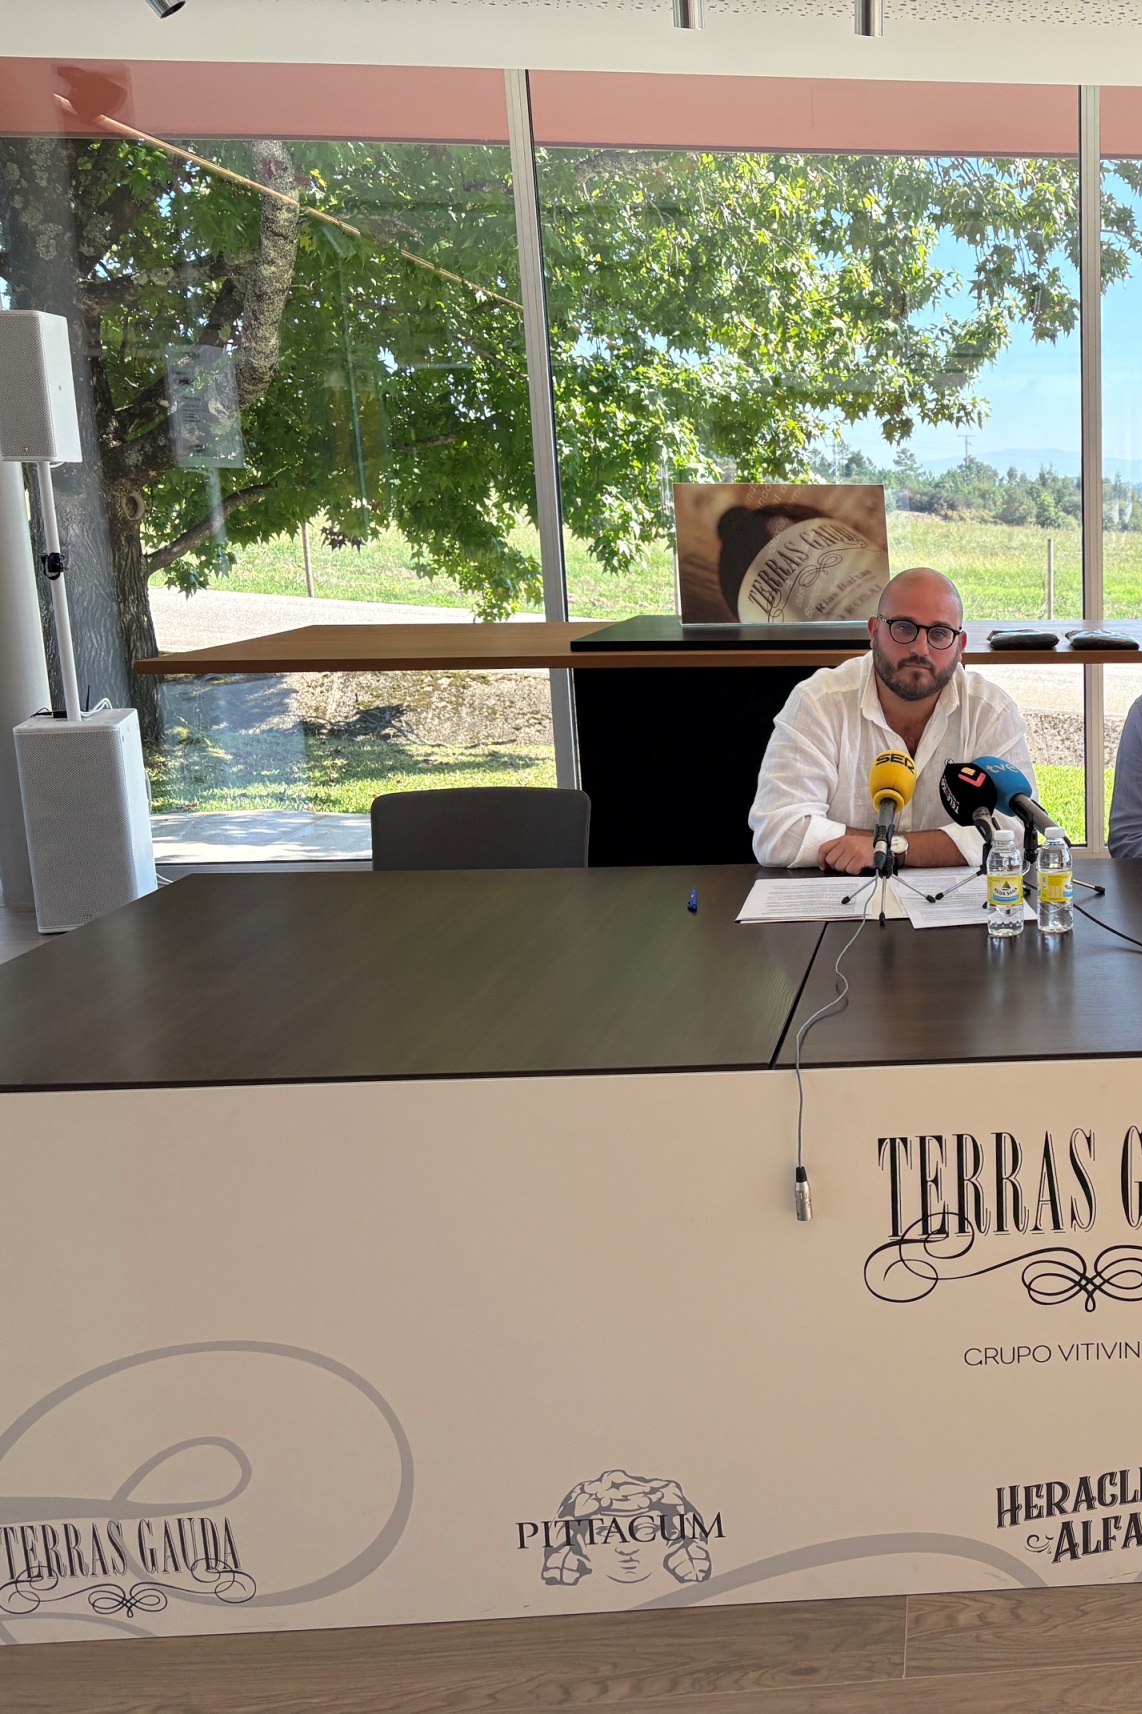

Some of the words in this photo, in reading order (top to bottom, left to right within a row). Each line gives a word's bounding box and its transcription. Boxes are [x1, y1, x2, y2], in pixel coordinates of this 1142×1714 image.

[748, 541, 809, 614] TERRAS
[875, 753, 916, 775] SER
[985, 763, 1020, 774] tve
[878, 1128, 1098, 1241] TERRAS
[964, 1344, 1052, 1366] GRUPO
[0, 1520, 127, 1580] TERRAS
[137, 1516, 242, 1575] GAUDA
[516, 1512, 726, 1549] PITTACUM
